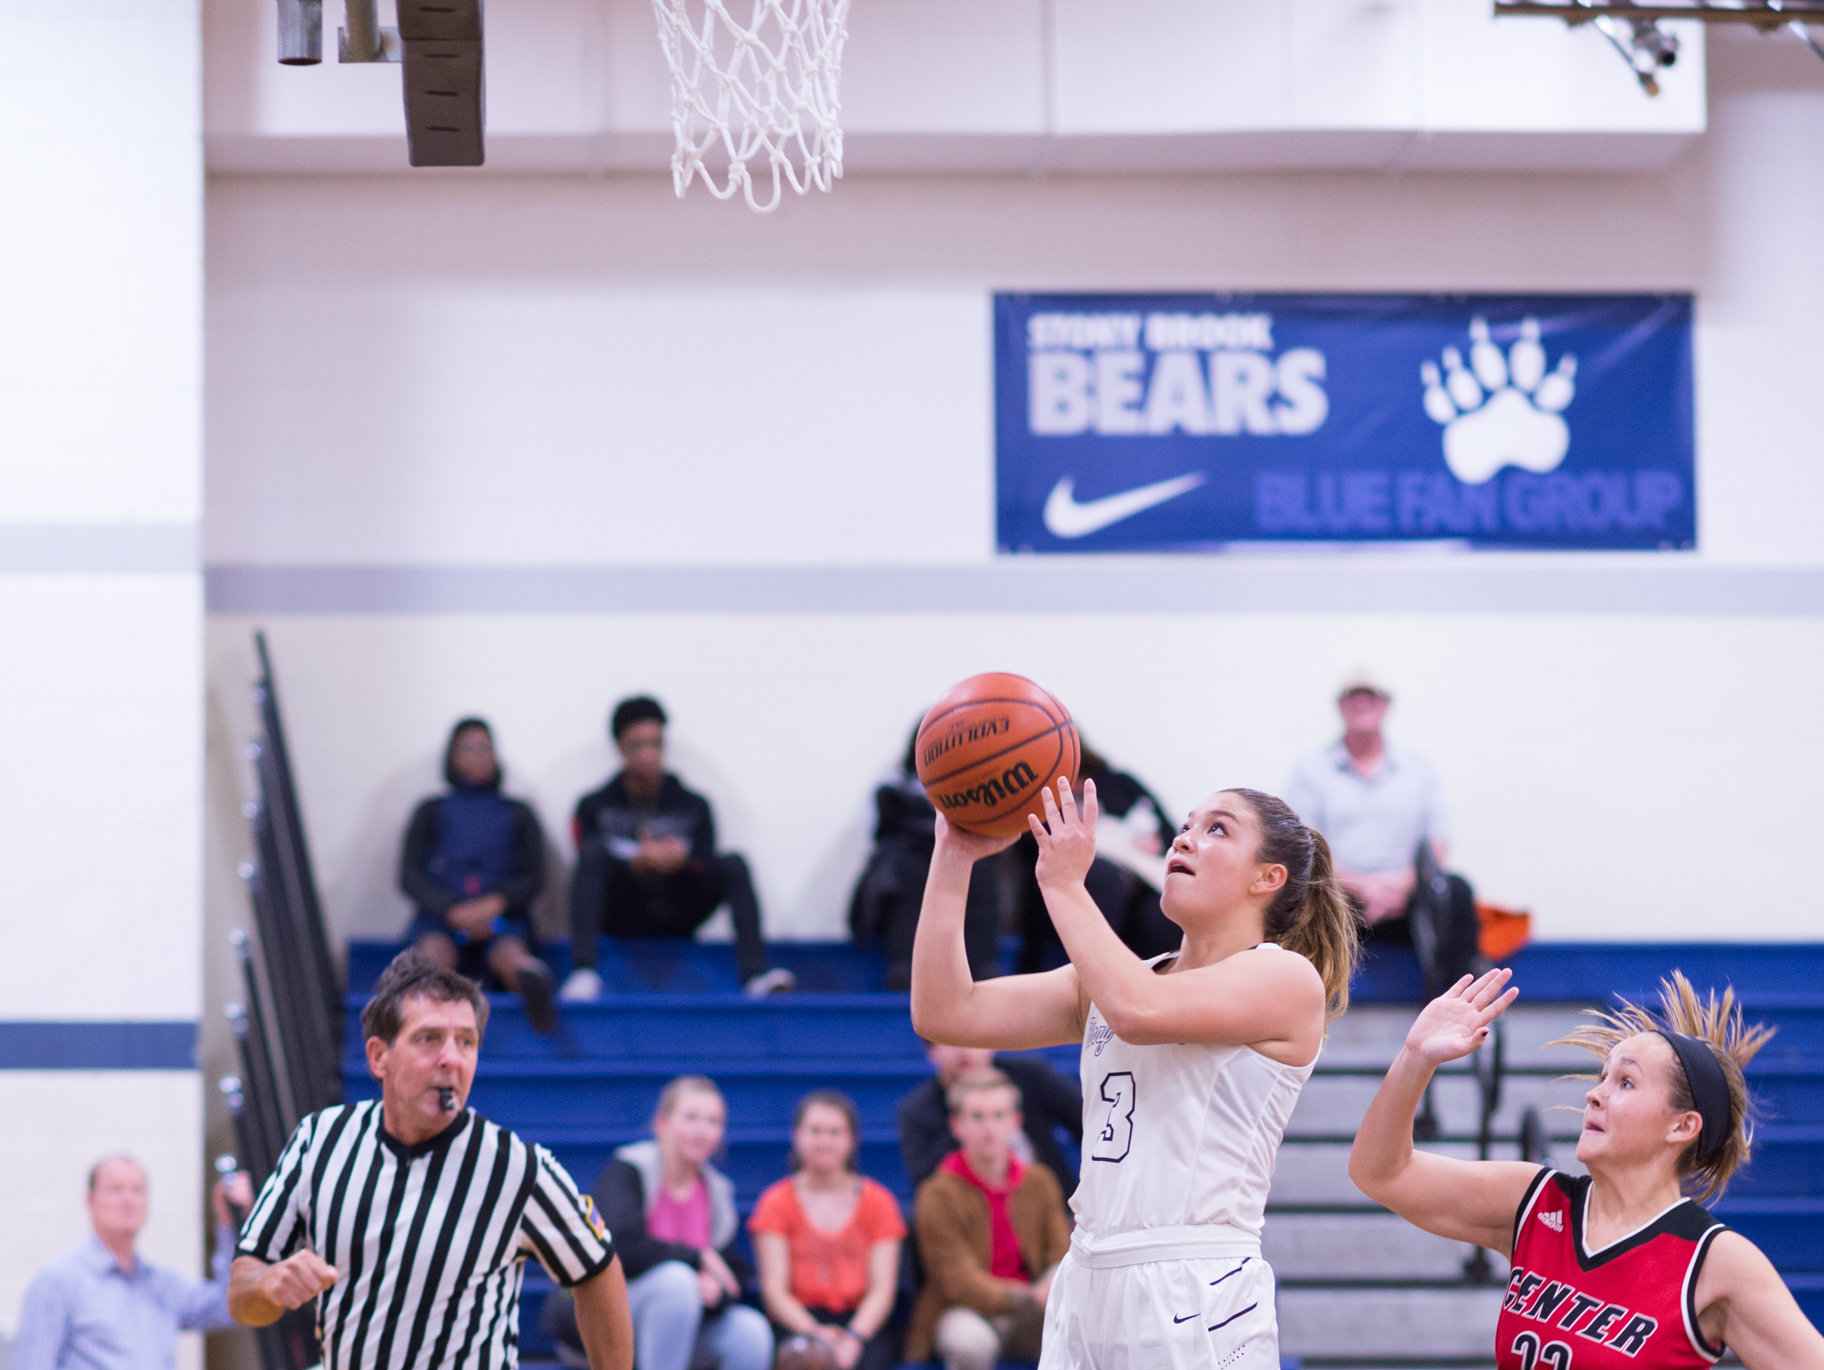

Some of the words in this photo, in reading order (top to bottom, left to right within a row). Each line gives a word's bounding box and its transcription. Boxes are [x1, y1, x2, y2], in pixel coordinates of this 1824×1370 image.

[1029, 349, 1328, 436] BEARS
[1255, 472, 1391, 531] BLUE
[1400, 472, 1498, 531] FAN
[1504, 472, 1683, 531] GROUP
[937, 761, 1039, 808] Wilson
[1092, 1071, 1136, 1163] 3
[1503, 1267, 1658, 1358] CENTER
